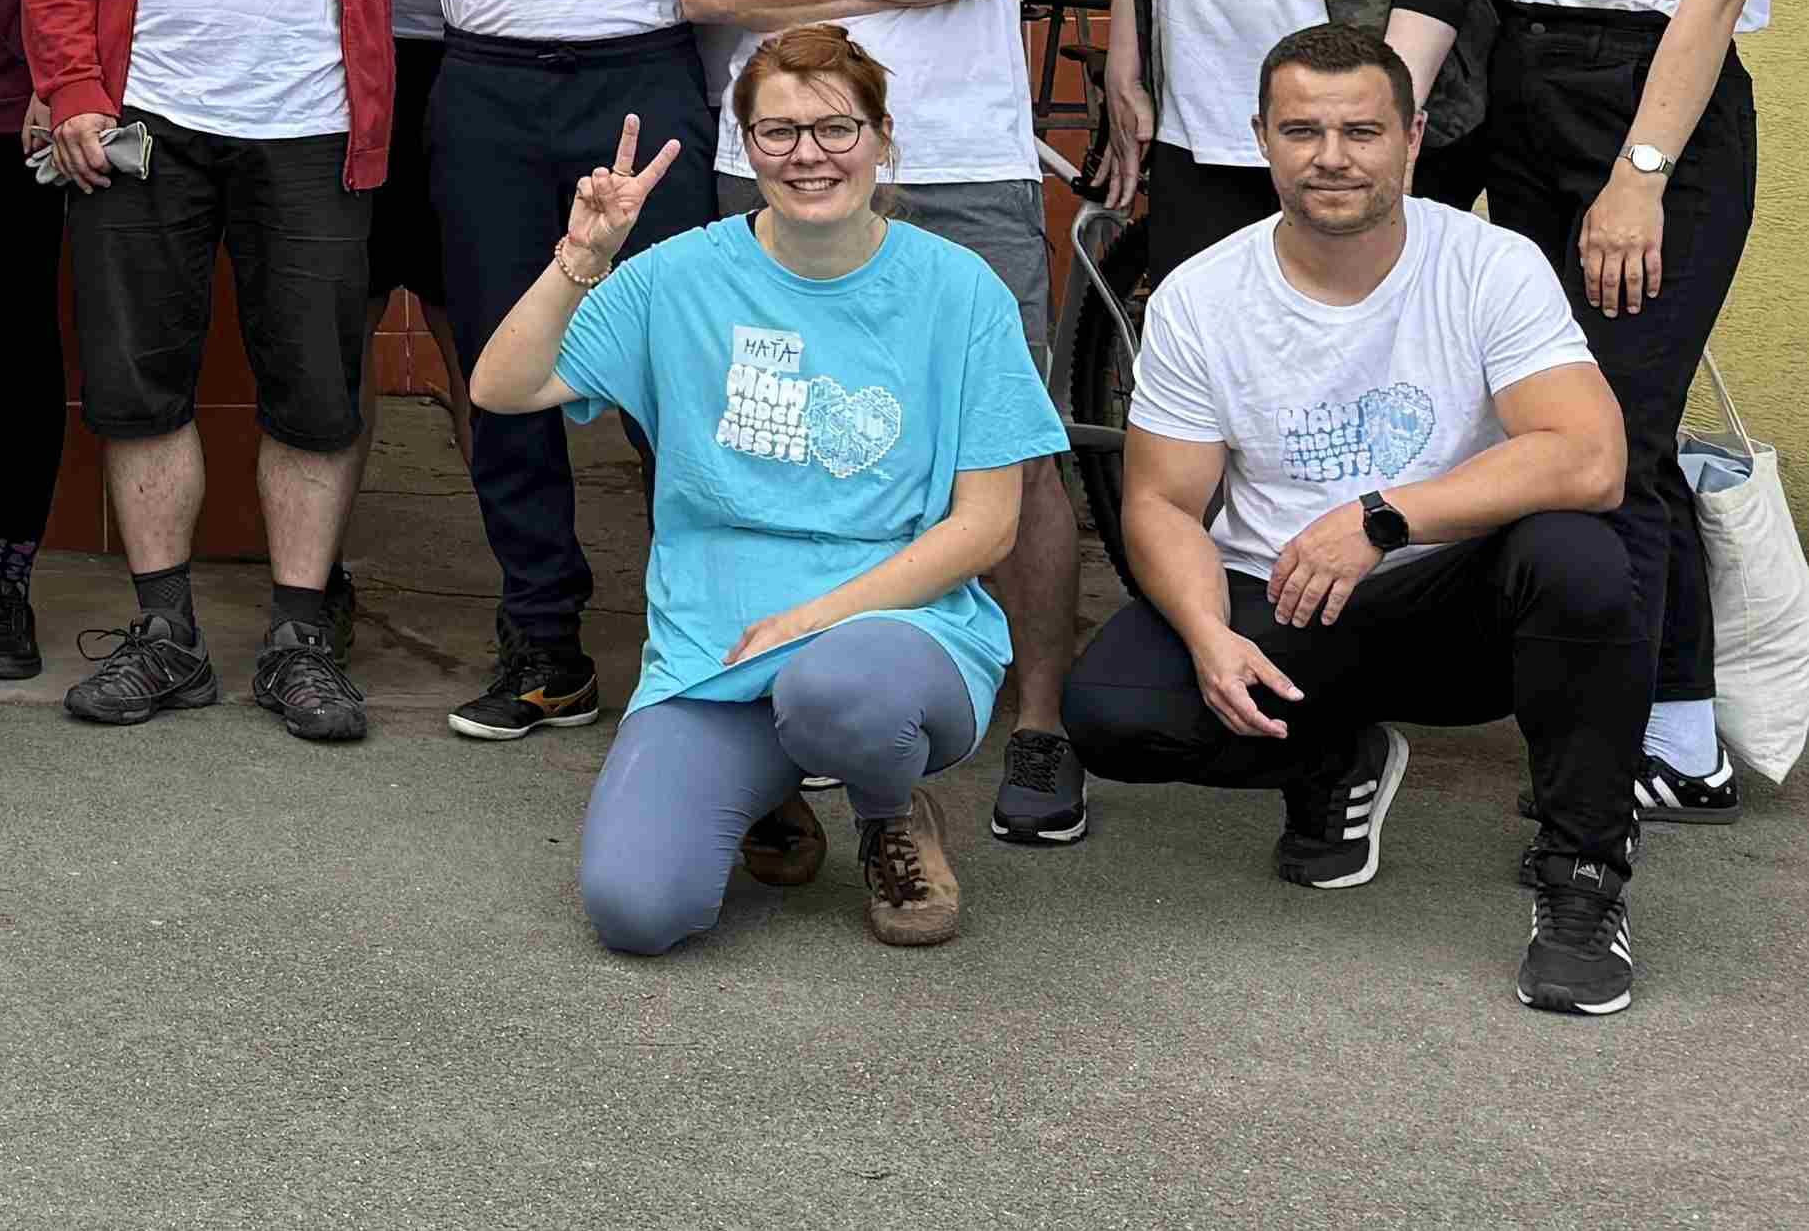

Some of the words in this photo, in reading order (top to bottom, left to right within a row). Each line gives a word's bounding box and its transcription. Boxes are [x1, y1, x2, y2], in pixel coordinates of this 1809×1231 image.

[726, 363, 811, 411] MÁM
[1276, 402, 1365, 436] MÁM
[715, 418, 811, 467] MESTE
[1284, 425, 1364, 452] SRDCE
[1280, 452, 1373, 483] MESTE
